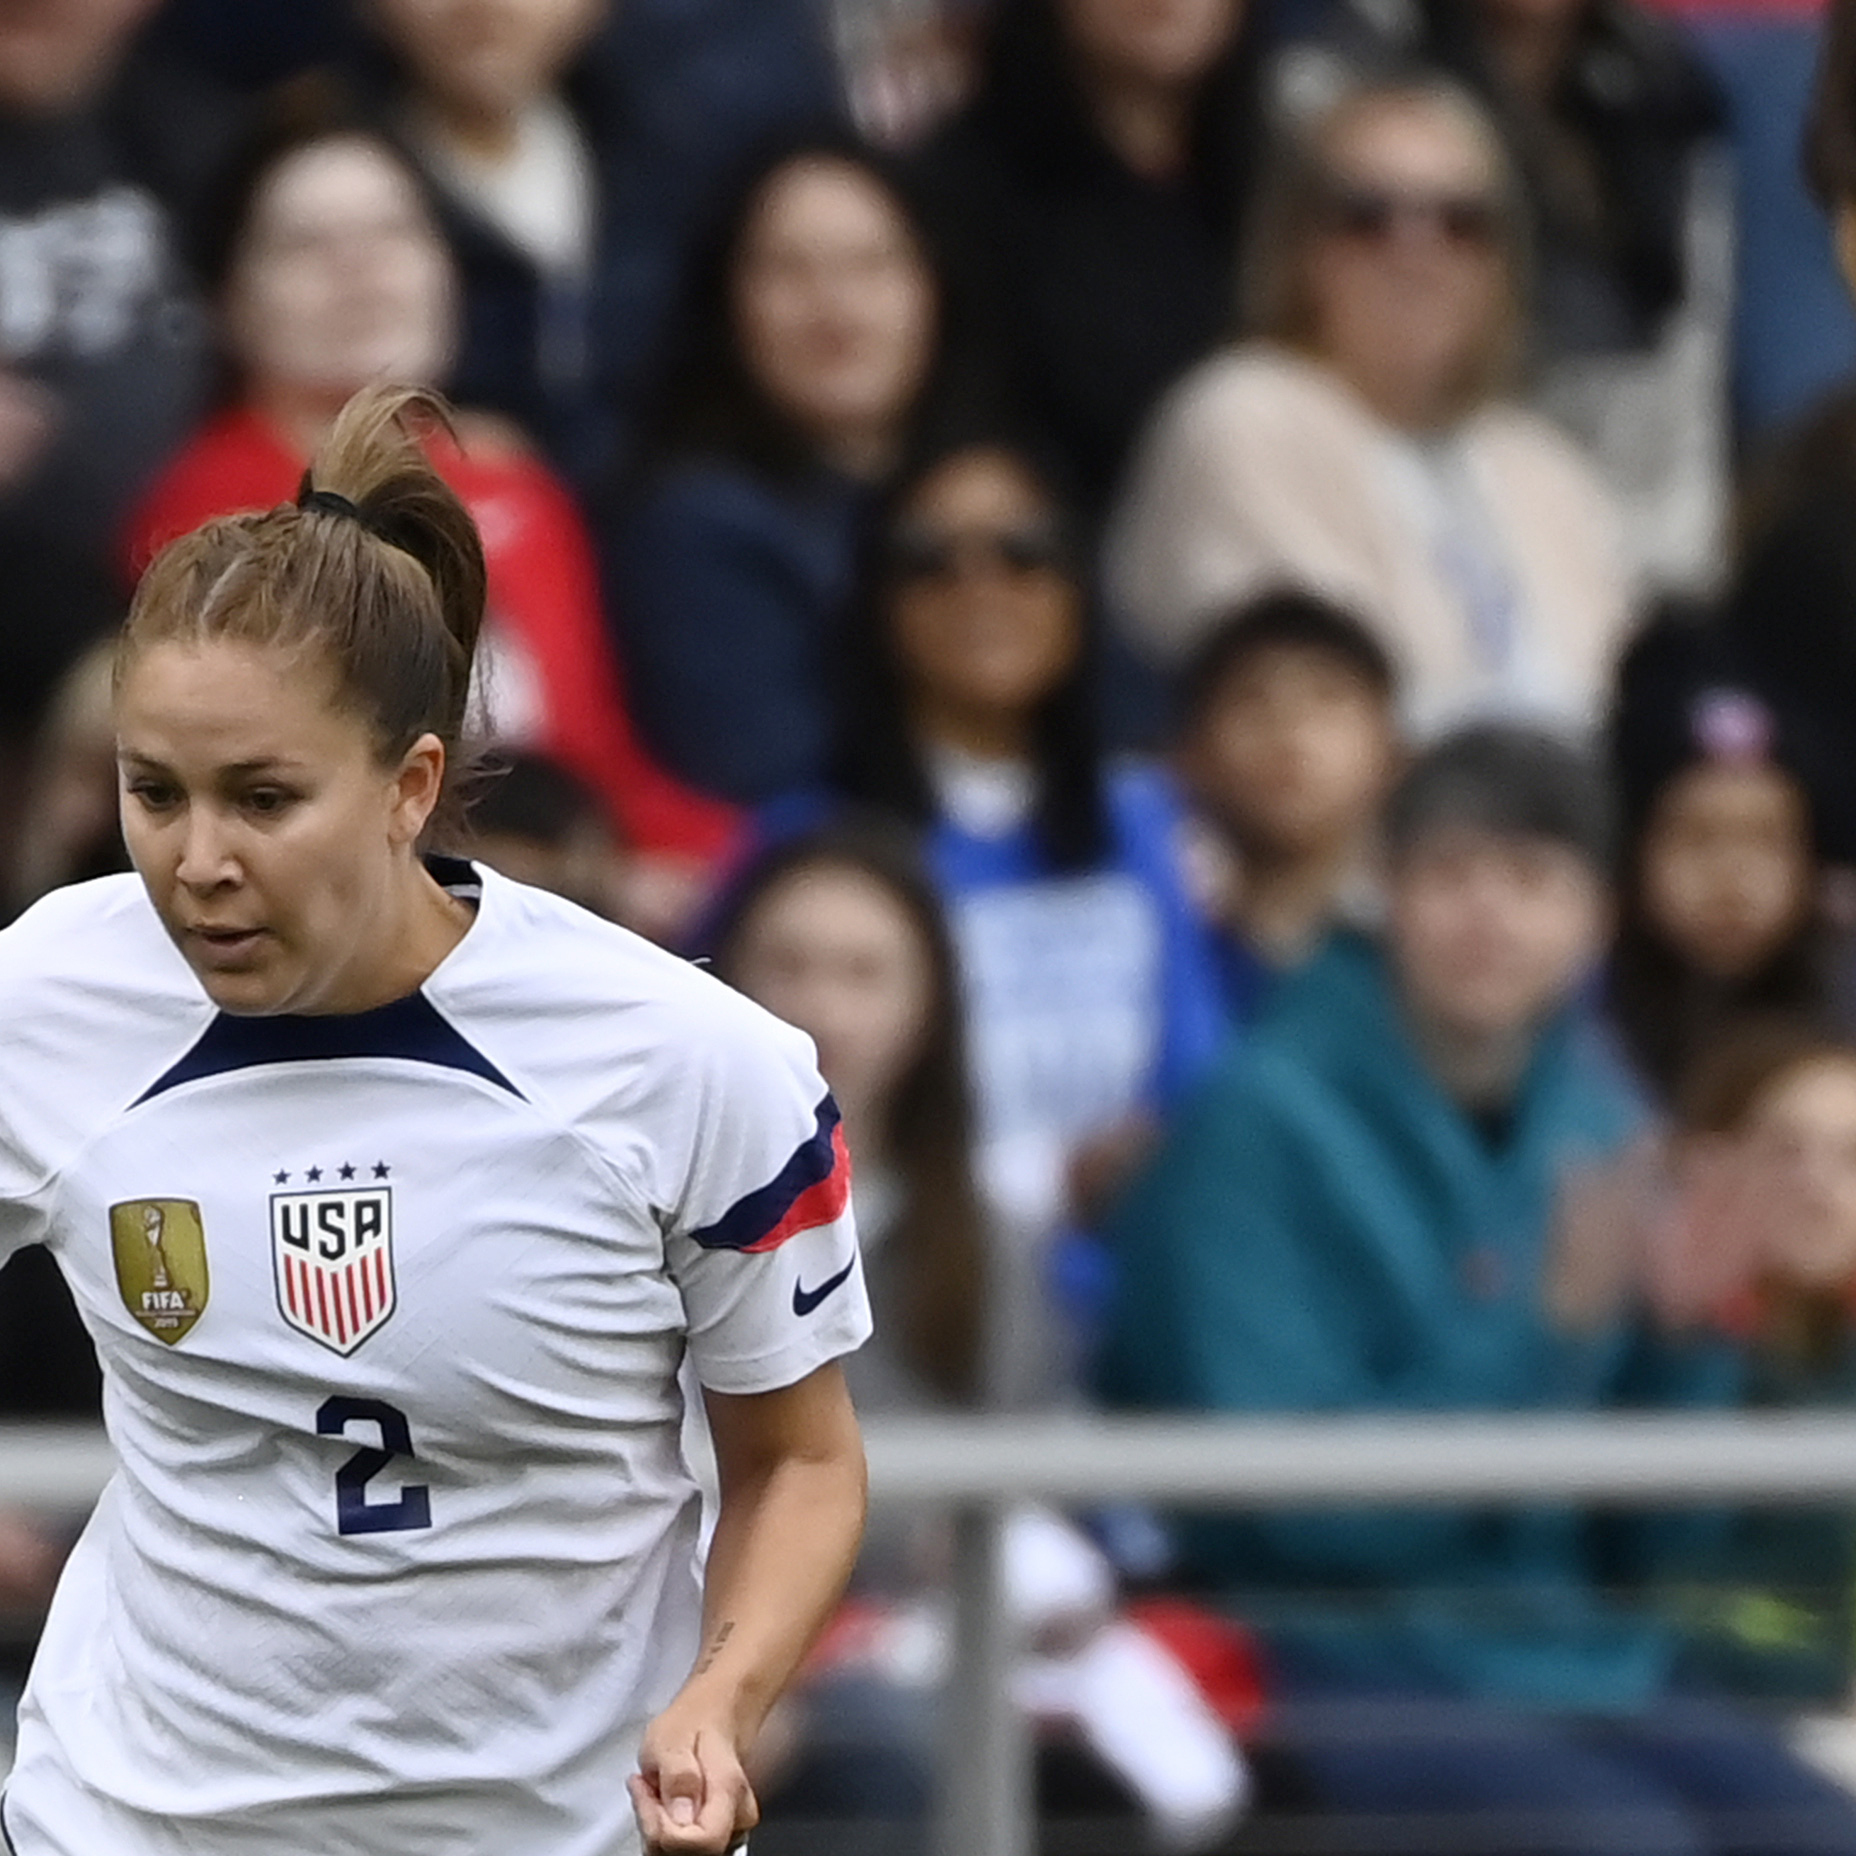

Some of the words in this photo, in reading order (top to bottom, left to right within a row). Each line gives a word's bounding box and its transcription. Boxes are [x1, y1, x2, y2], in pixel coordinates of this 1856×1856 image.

[281, 1198, 383, 1262] USA
[141, 1290, 185, 1311] FIFA
[316, 1394, 432, 1536] 2
